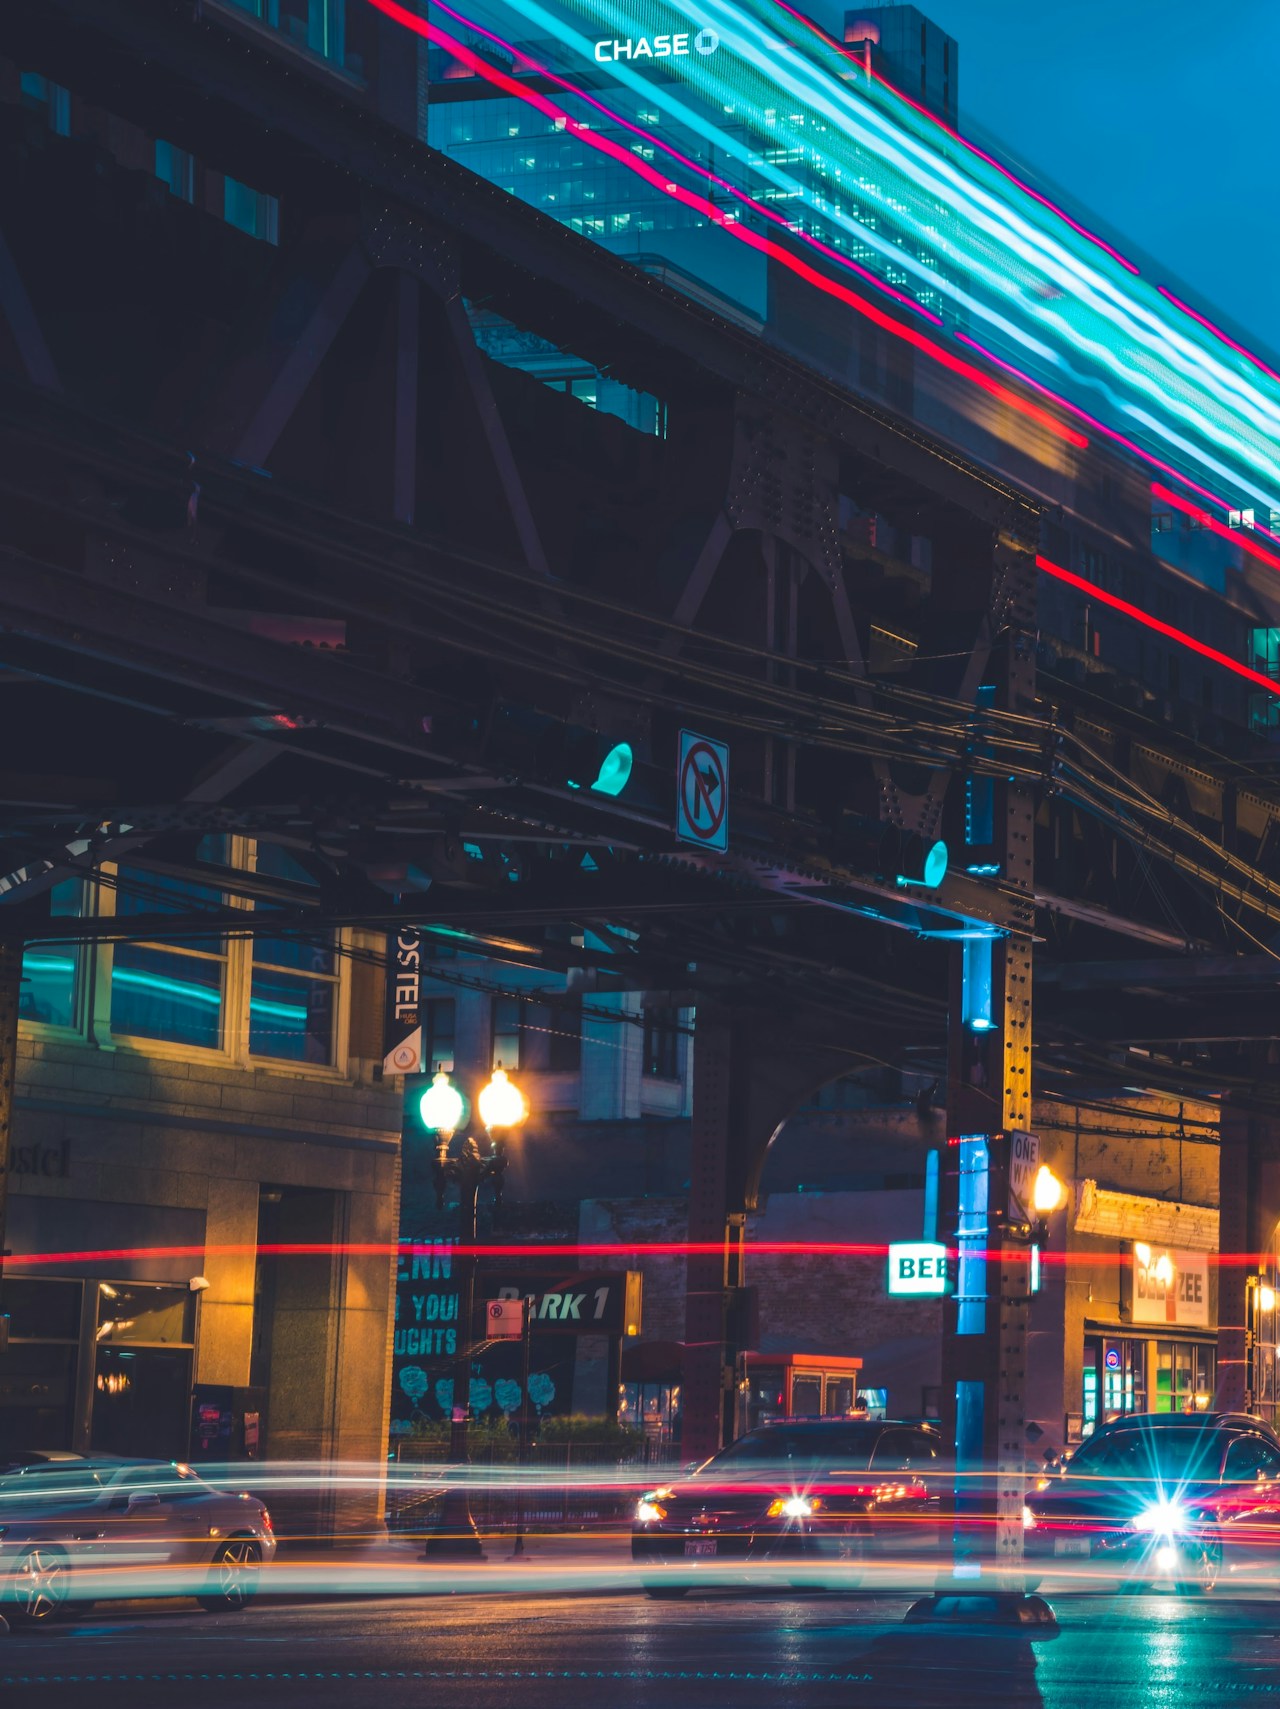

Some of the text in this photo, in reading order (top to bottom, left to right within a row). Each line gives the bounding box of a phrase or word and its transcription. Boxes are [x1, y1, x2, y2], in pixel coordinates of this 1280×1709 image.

[594, 33, 690, 62] CHASE
[1015, 1138, 1037, 1163] ONE
[397, 1237, 460, 1281] ENN
[411, 1292, 460, 1321] YOU
[593, 1287, 610, 1319] 1
